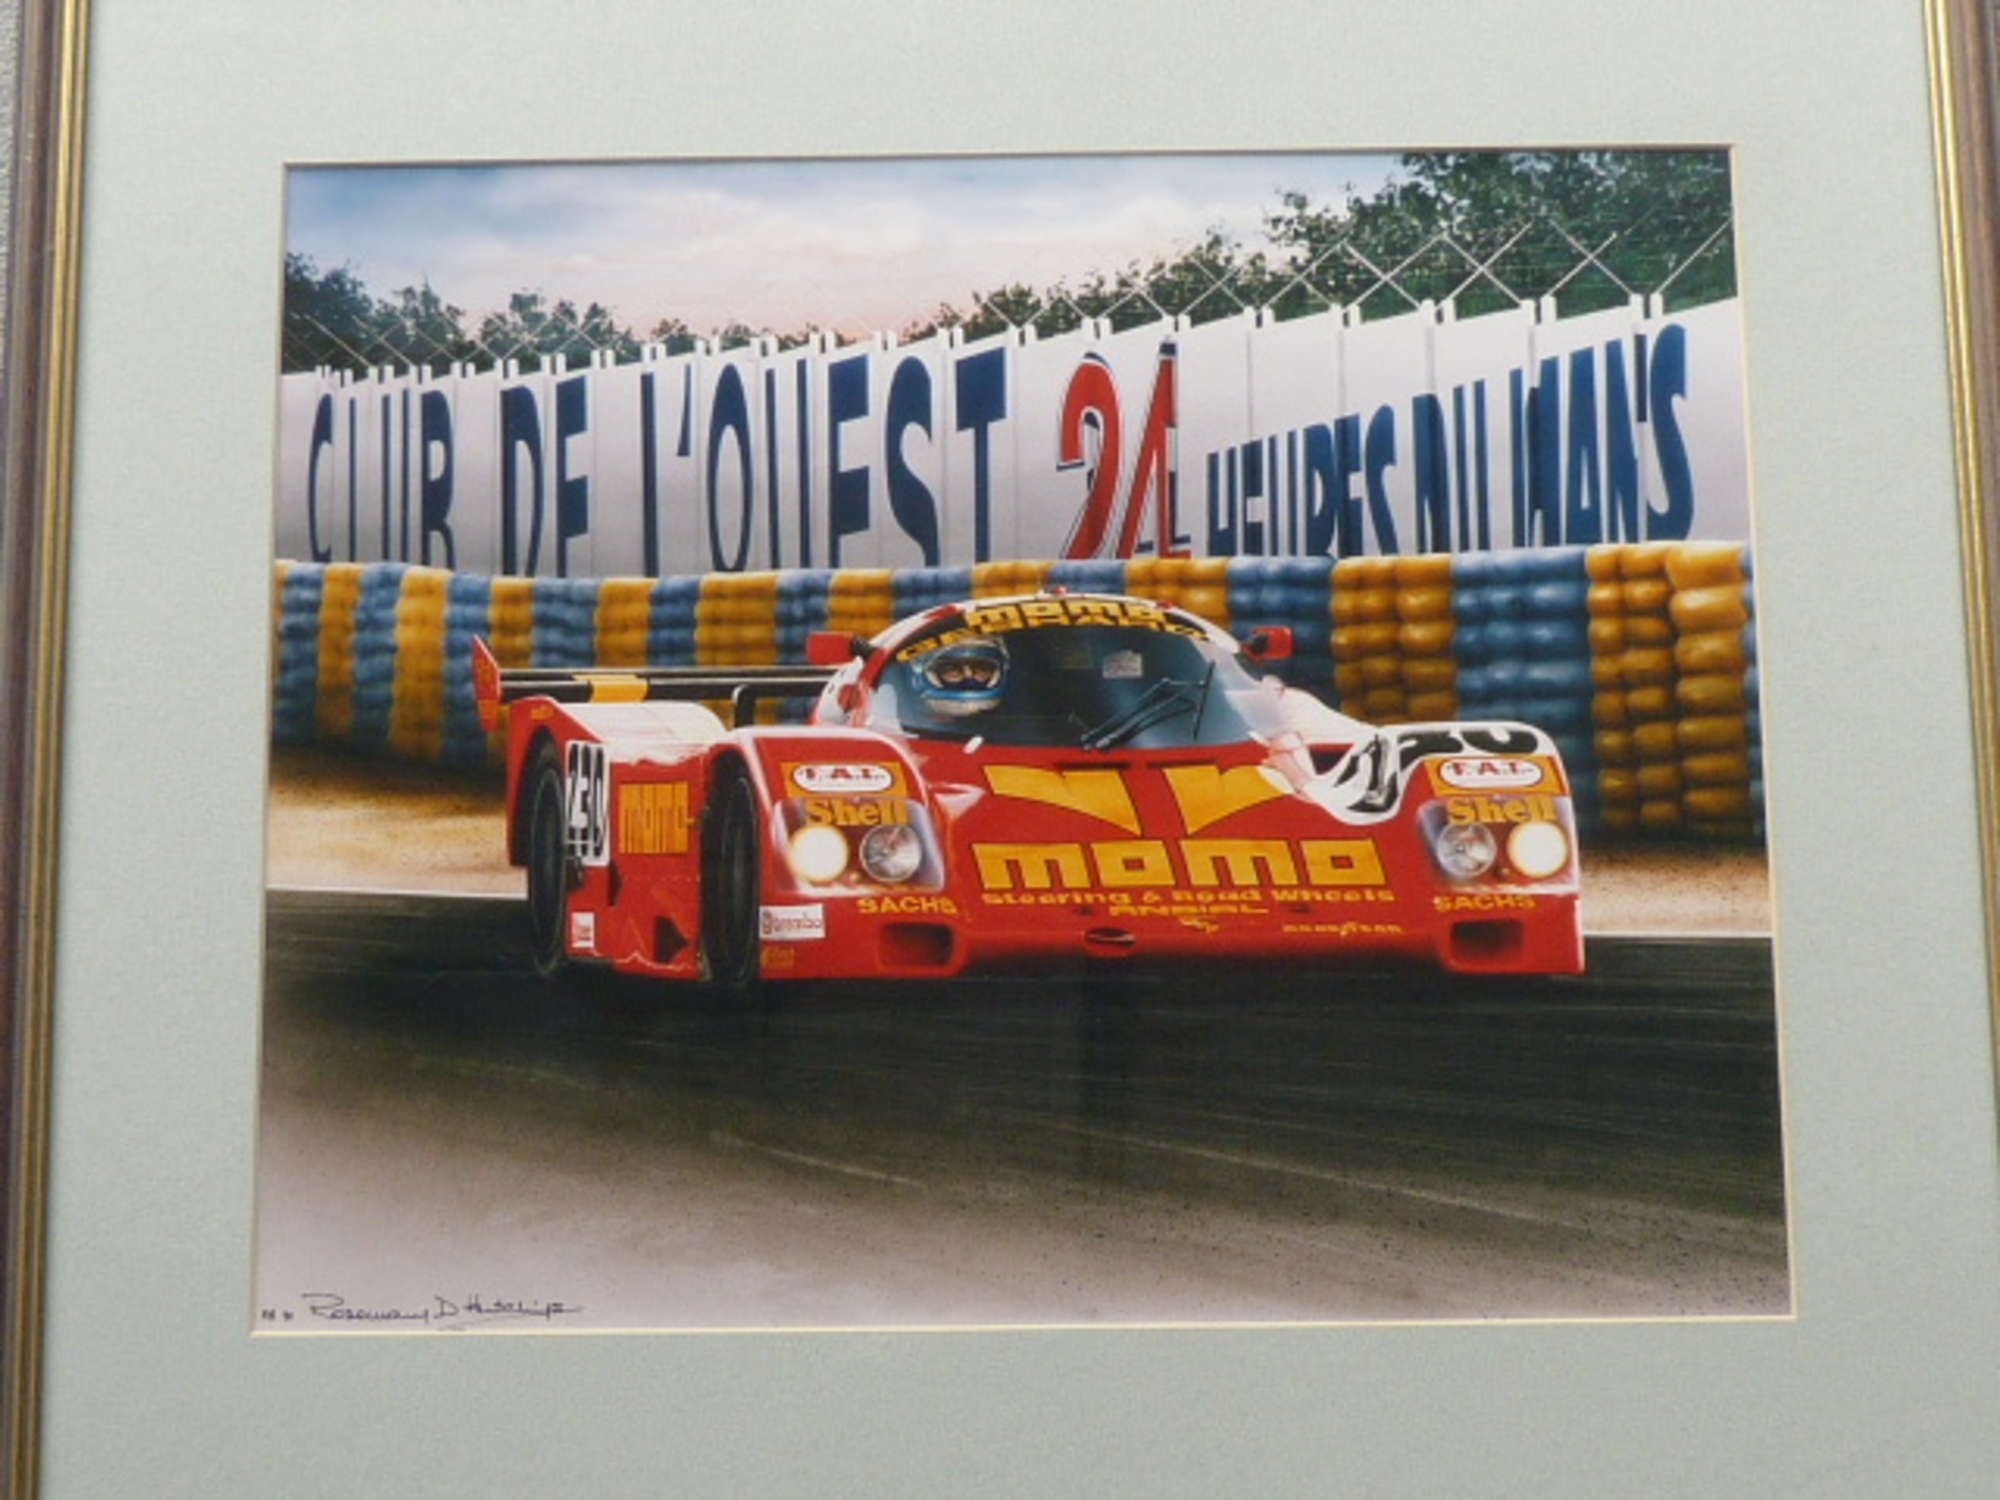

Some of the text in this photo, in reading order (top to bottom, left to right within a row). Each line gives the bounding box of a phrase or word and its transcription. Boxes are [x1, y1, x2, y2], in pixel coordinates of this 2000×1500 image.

[500, 375, 589, 578] DE
[1055, 340, 1192, 560] 24
[806, 799, 908, 826] Shell
[1447, 796, 1557, 824] Shell
[971, 837, 1386, 889] momo
[857, 895, 958, 915] SACHS
[1271, 888, 1395, 901] Wheels
[1433, 894, 1536, 913] SACHS
